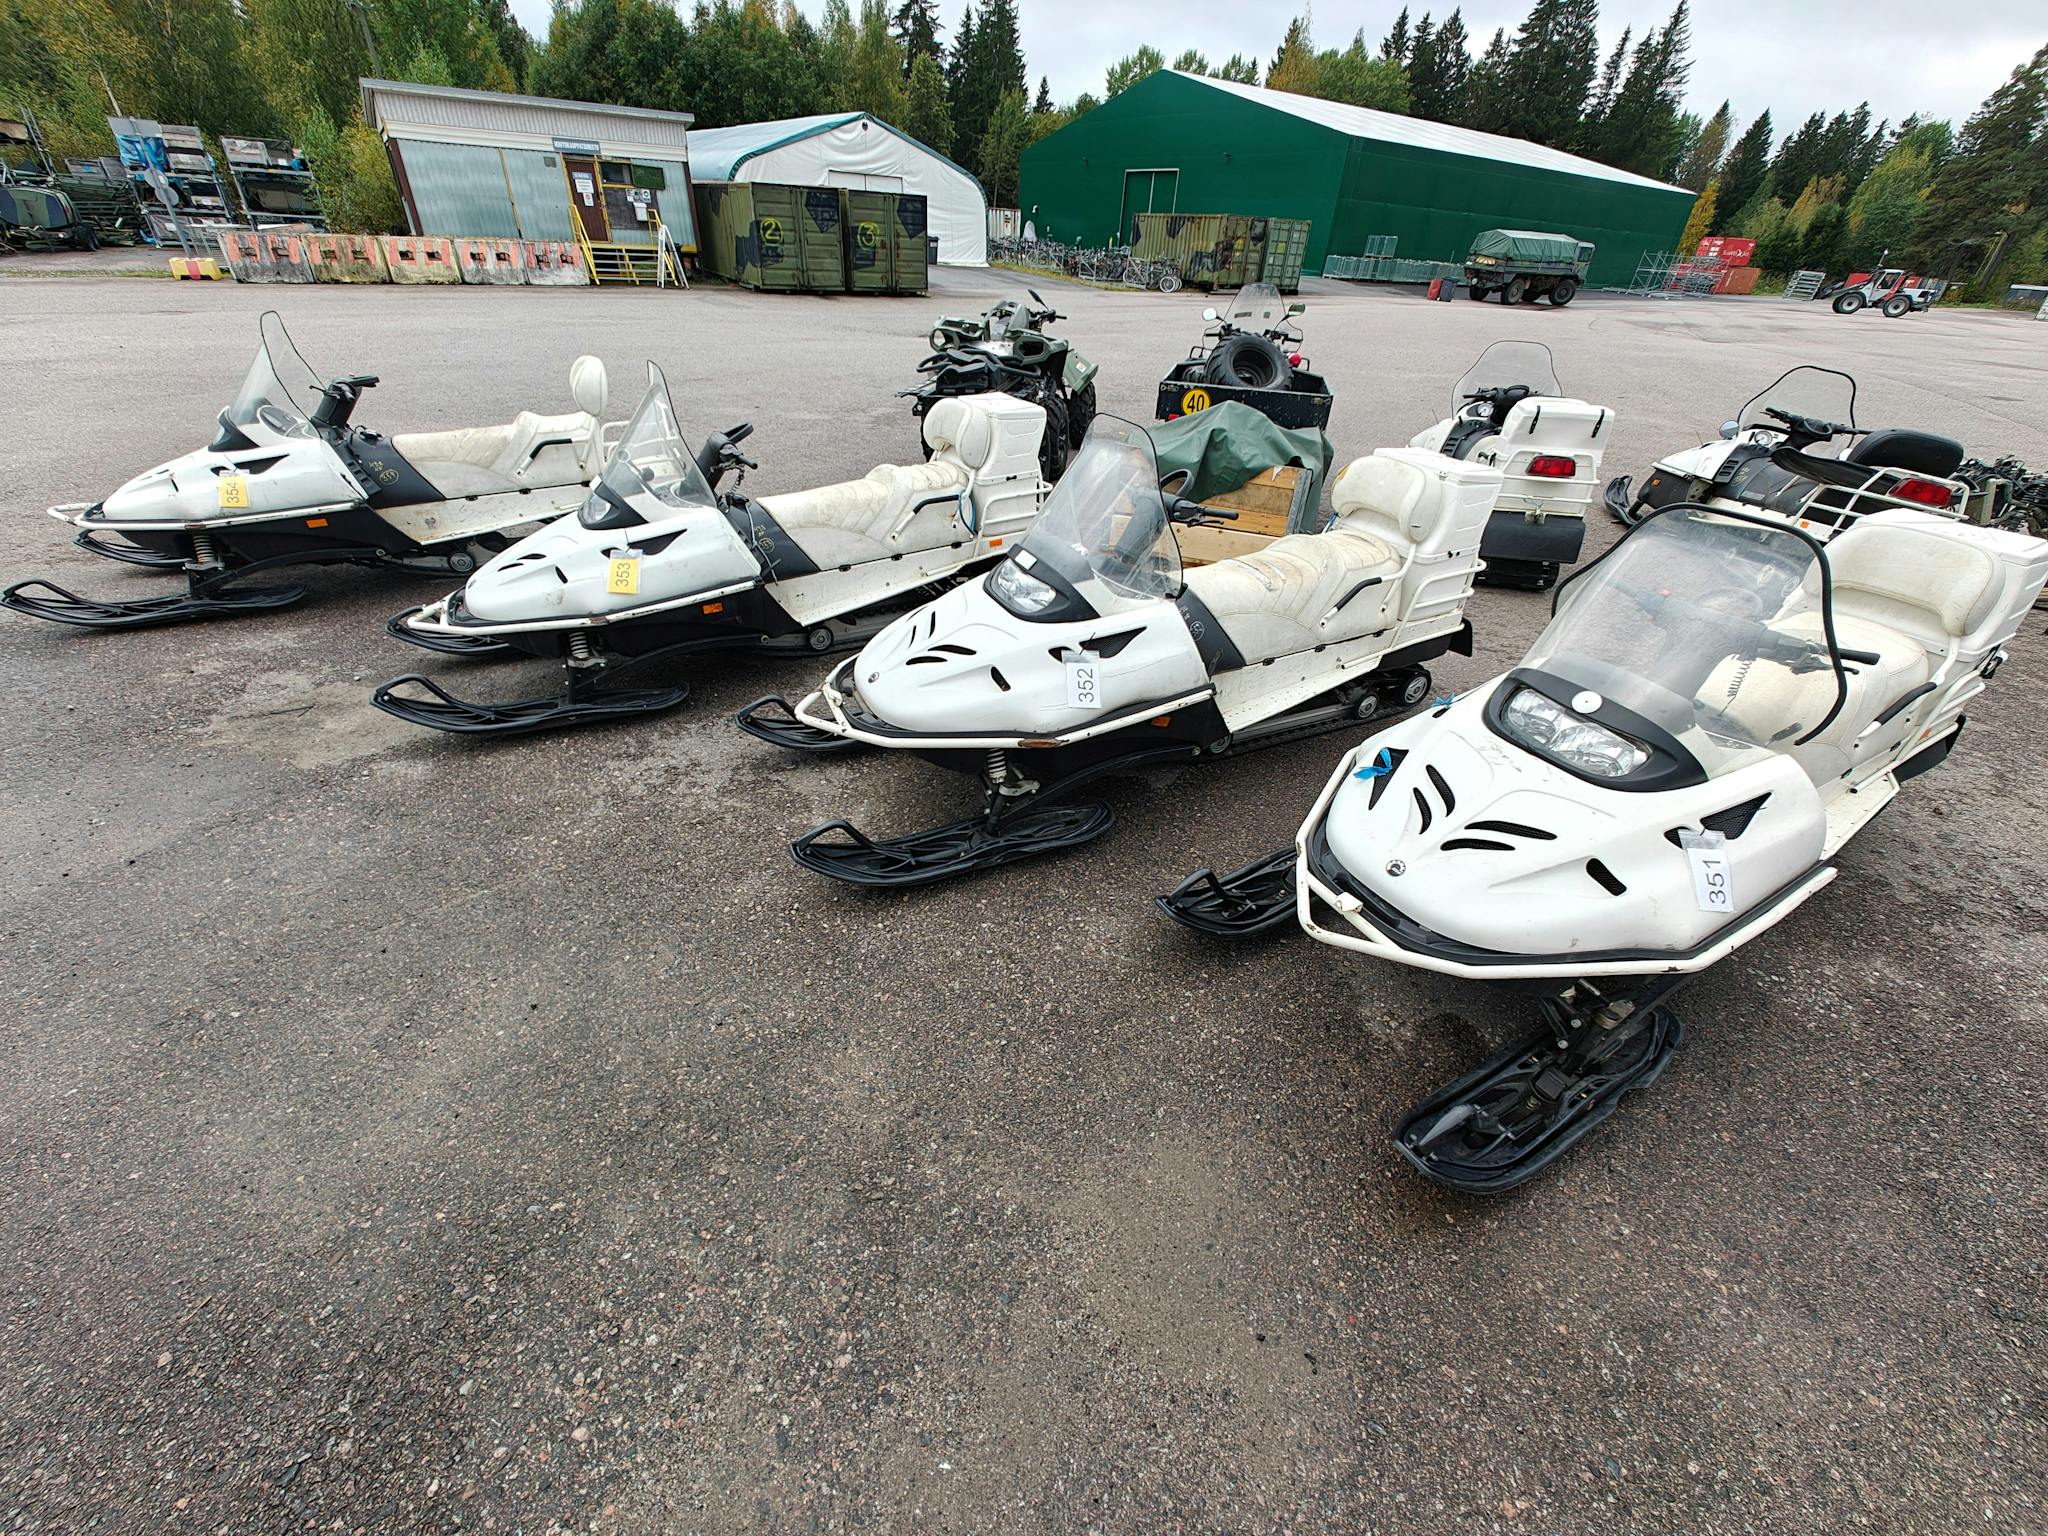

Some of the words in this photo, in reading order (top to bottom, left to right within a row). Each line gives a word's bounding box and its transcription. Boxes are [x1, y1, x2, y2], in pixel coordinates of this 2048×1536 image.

[1187, 393, 1205, 413] 40
[226, 481, 240, 504] 354
[615, 562, 631, 588] 353
[1077, 668, 1095, 703] 352
[1702, 860, 1726, 905] 351
